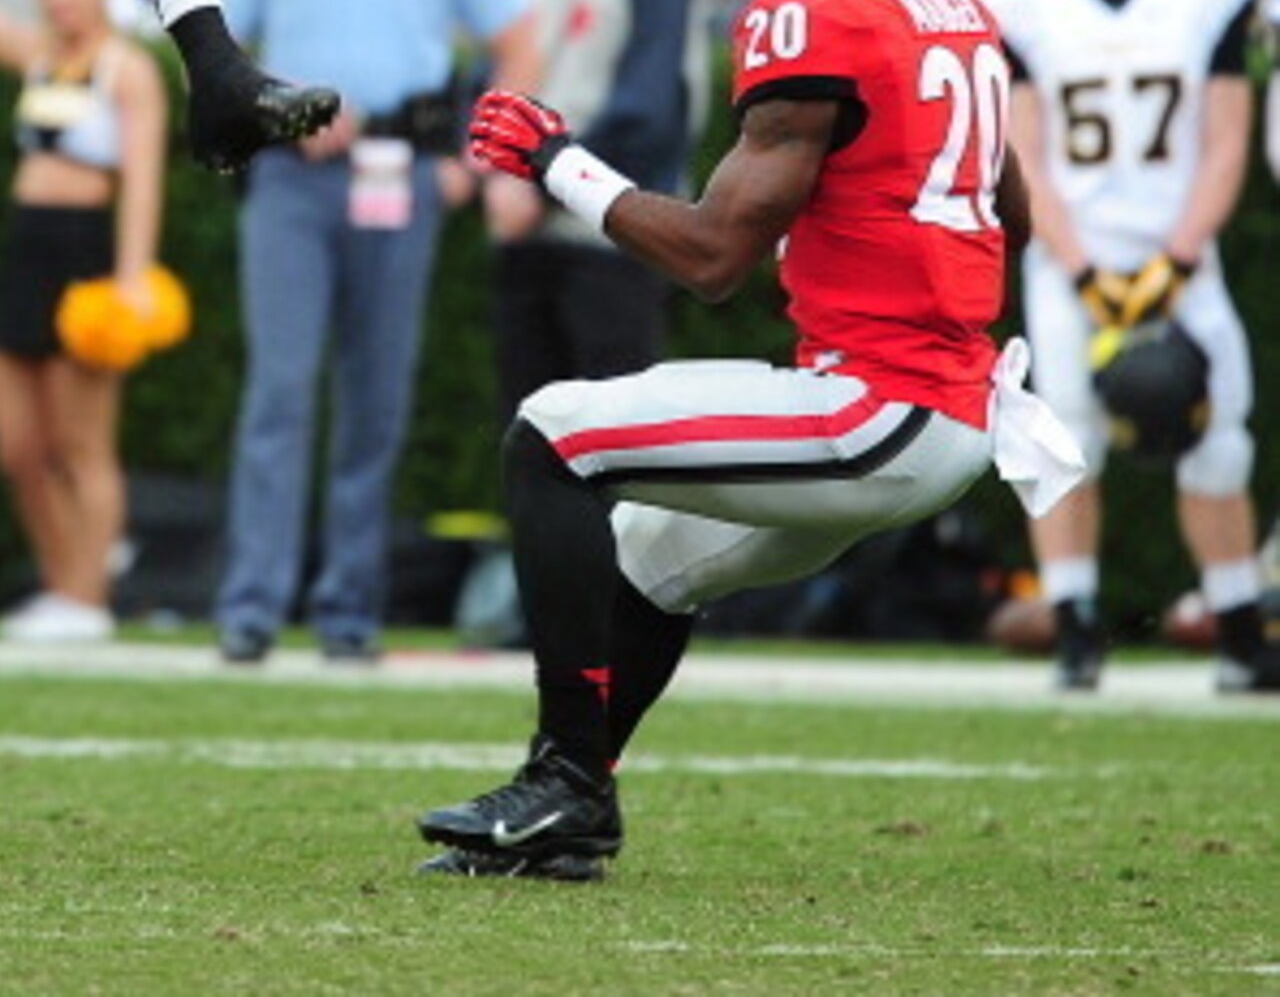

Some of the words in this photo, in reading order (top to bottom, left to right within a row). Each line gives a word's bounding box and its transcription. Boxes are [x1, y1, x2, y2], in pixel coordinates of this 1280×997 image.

[744, 2, 807, 70] 20
[908, 43, 1009, 232] 20
[1061, 75, 1182, 165] 57
